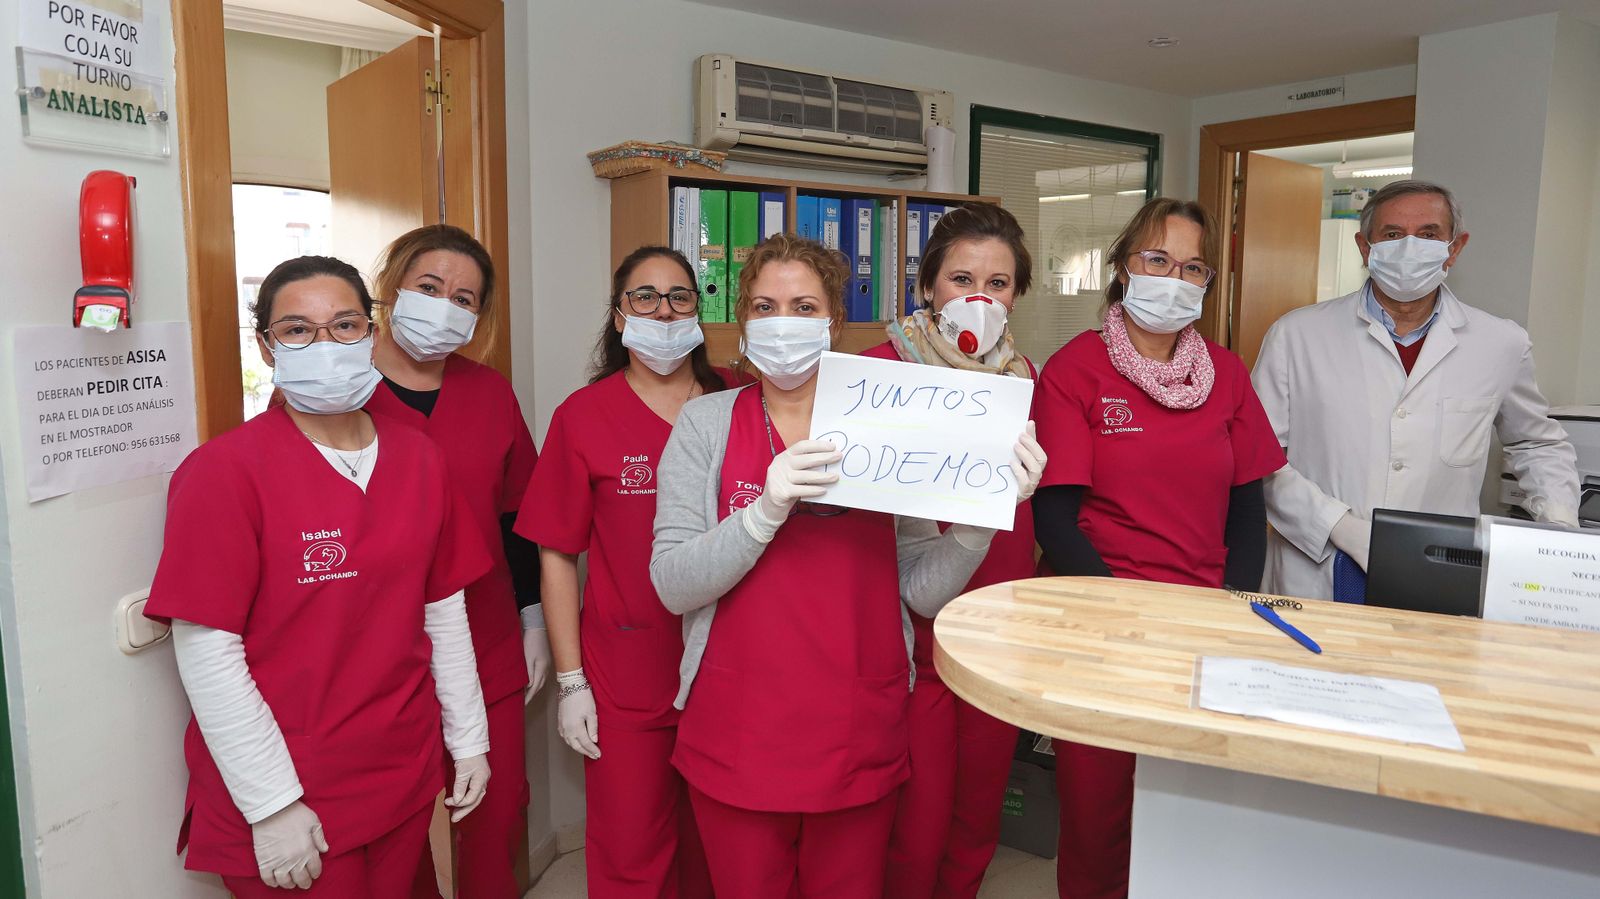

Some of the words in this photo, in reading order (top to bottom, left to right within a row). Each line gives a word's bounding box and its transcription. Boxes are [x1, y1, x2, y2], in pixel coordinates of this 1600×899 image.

[48, 1, 85, 28] POR
[92, 14, 138, 44] FAVOR
[64, 34, 110, 62] COJA
[114, 47, 132, 67] SU
[73, 62, 131, 92] TURNO
[47, 88, 147, 125] ANALISTA
[35, 360, 54, 372] LOS
[56, 356, 110, 370] PACIENTES
[112, 355, 124, 366] DE
[126, 349, 167, 364] ASISA
[37, 387, 84, 402] DEBERAN
[87, 379, 129, 396] PEDIR
[132, 375, 163, 391] CITA
[844, 379, 991, 416] JUNTOS
[39, 412, 65, 425] PARA
[68, 410, 79, 421] EL
[81, 407, 100, 419] DIA
[102, 405, 115, 416] DE
[117, 402, 134, 414] LOS
[136, 398, 174, 411] ANÁLISIS
[41, 434, 54, 445] EN
[57, 432, 68, 443] EL
[70, 422, 134, 440] MOSTRADOR
[42, 455, 51, 465] O
[53, 451, 73, 464] POR
[76, 442, 129, 459] TELEFONO:
[131, 438, 148, 450] 956
[149, 433, 181, 447] 631568
[623, 454, 649, 463] Paula
[815, 431, 1012, 495] PODEMOS
[302, 528, 342, 541] Isabel
[1538, 547, 1597, 561] RECOGIDA
[319, 571, 358, 581] OCHANDO
[1524, 583, 1540, 591] DNI
